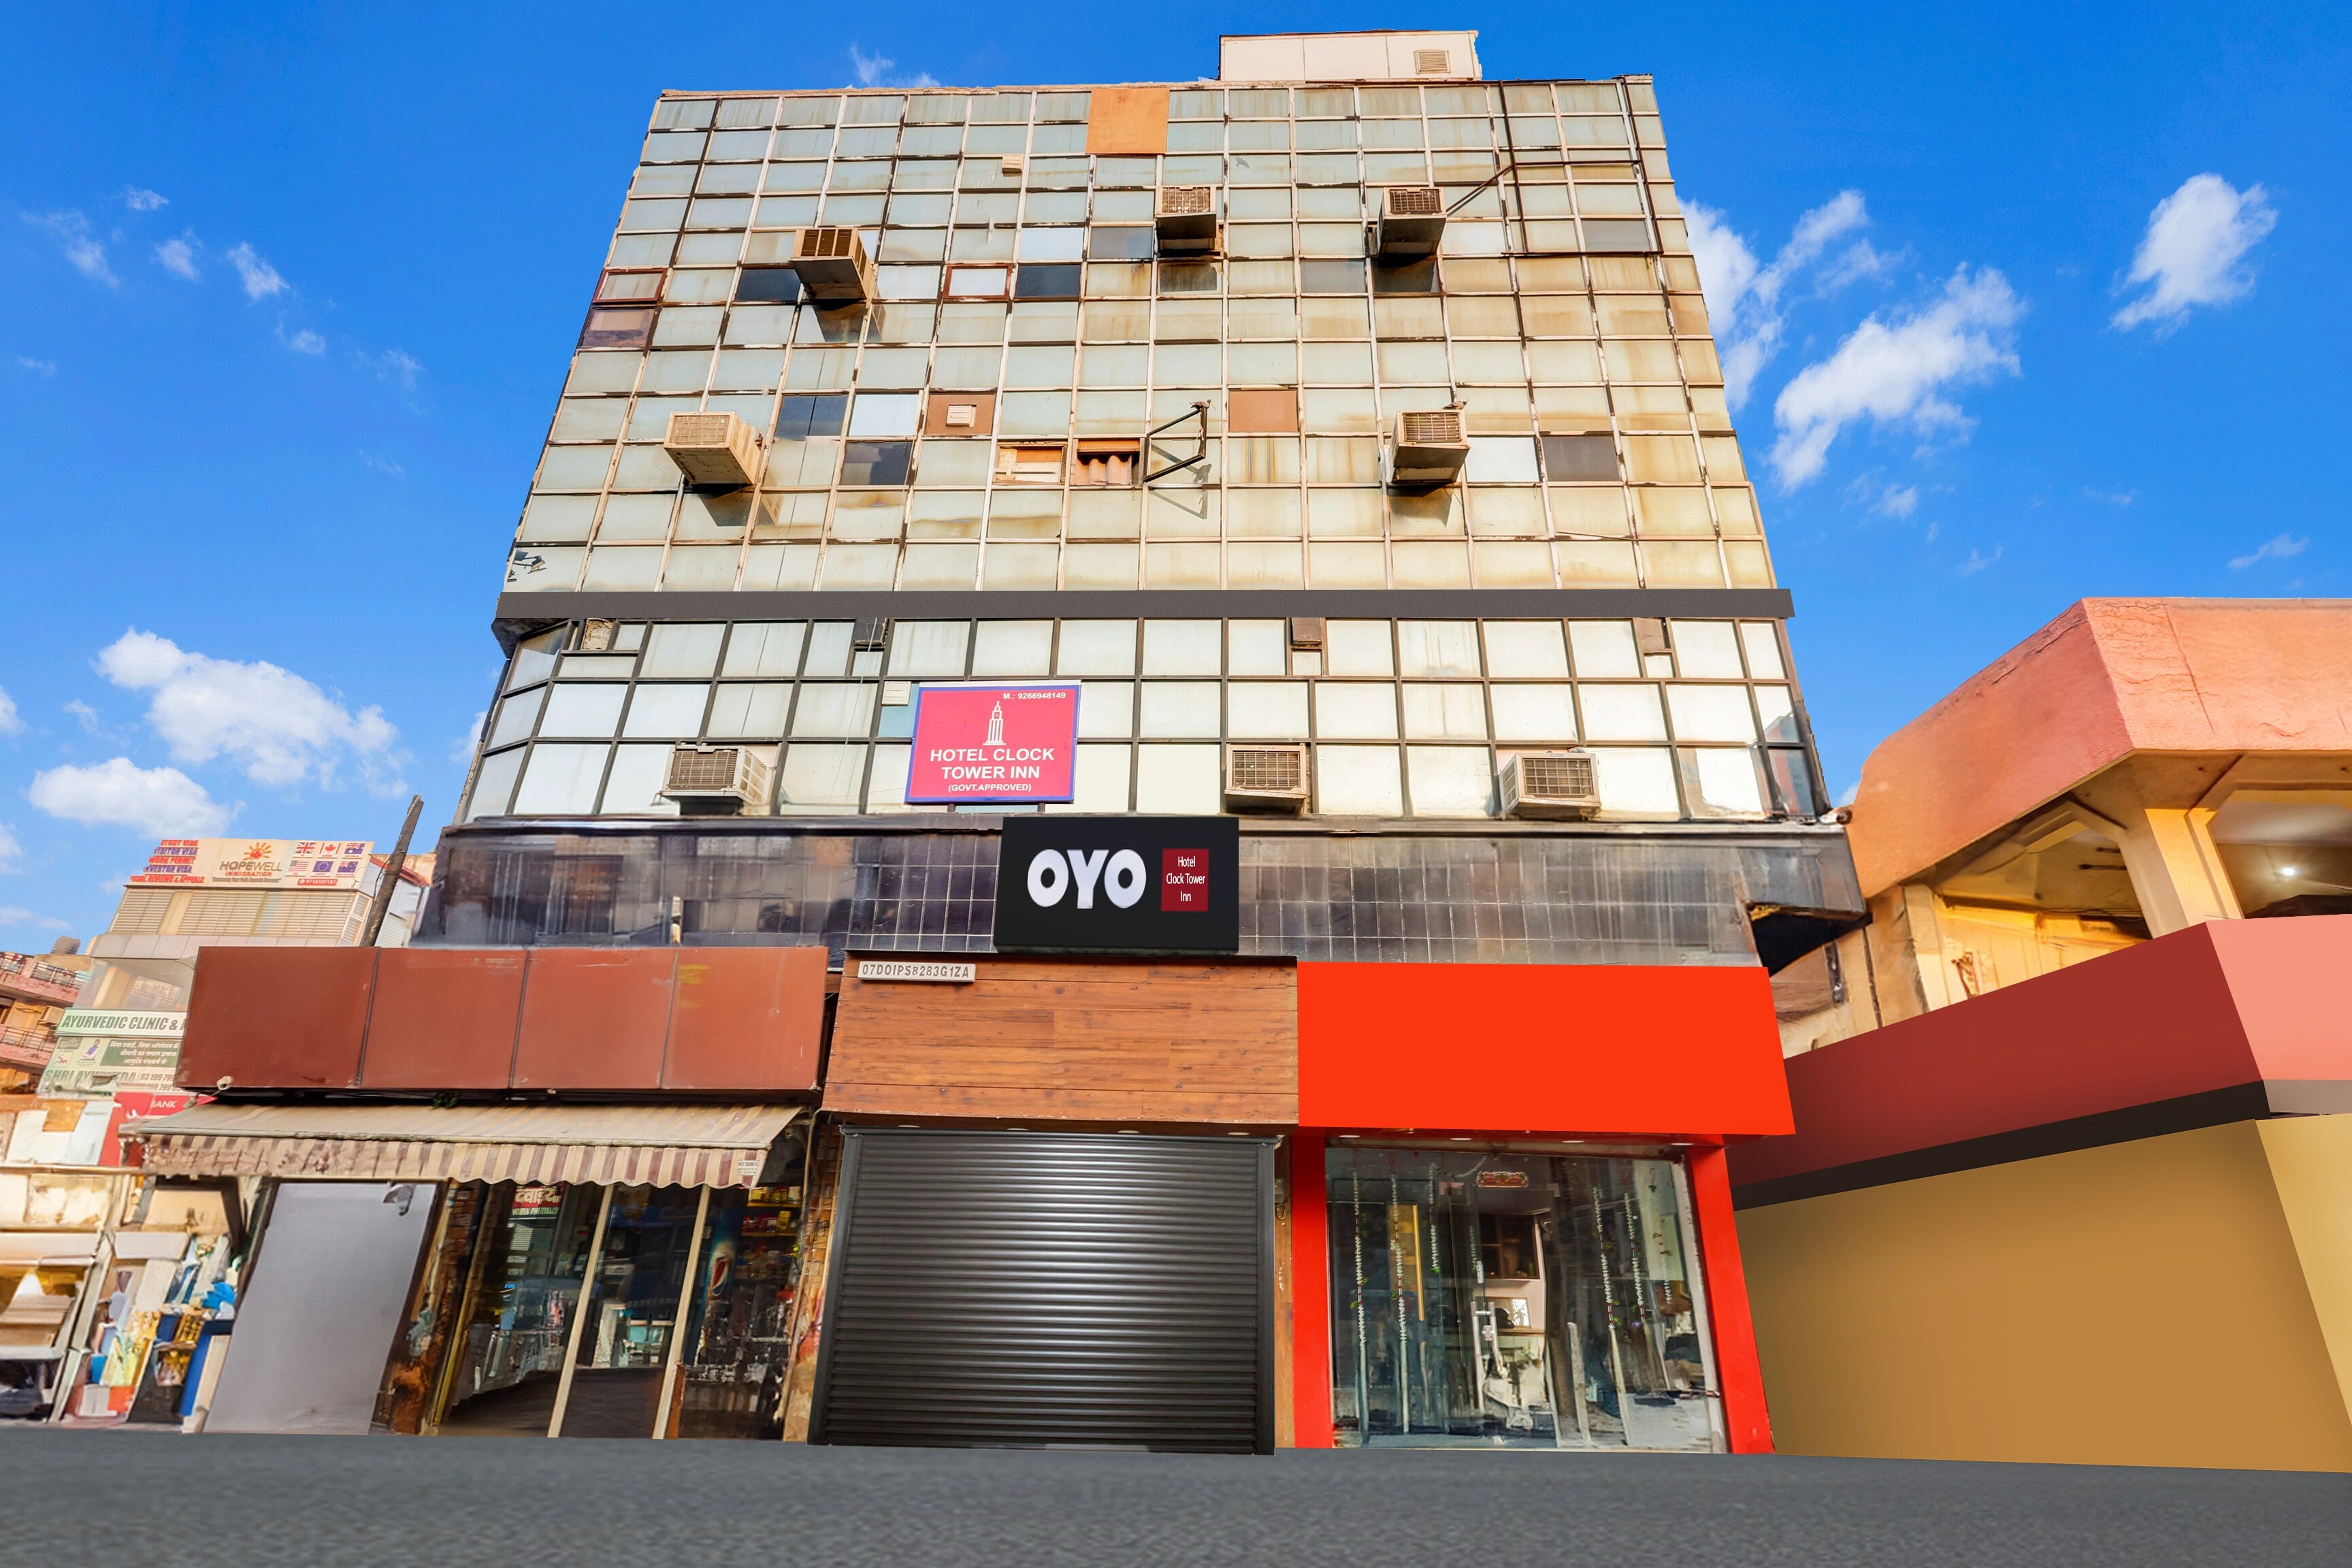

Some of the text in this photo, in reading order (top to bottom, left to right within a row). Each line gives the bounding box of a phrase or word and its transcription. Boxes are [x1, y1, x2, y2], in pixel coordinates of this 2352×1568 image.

[930, 748, 1055, 762] HOTEL CLOCK
[941, 766, 1040, 779] TOWER INN
[219, 861, 282, 871] HOPEWELL
[1177, 855, 1196, 867] Hotel
[1027, 849, 1147, 909] OYO
[1166, 872, 1205, 884] Clock Tower
[1180, 892, 1192, 902] Inn
[62, 1015, 128, 1029] AYURVEDIC
[128, 1017, 169, 1030] CLINIC
[169, 1019, 178, 1030] &
[46, 1070, 75, 1081] SHRI
